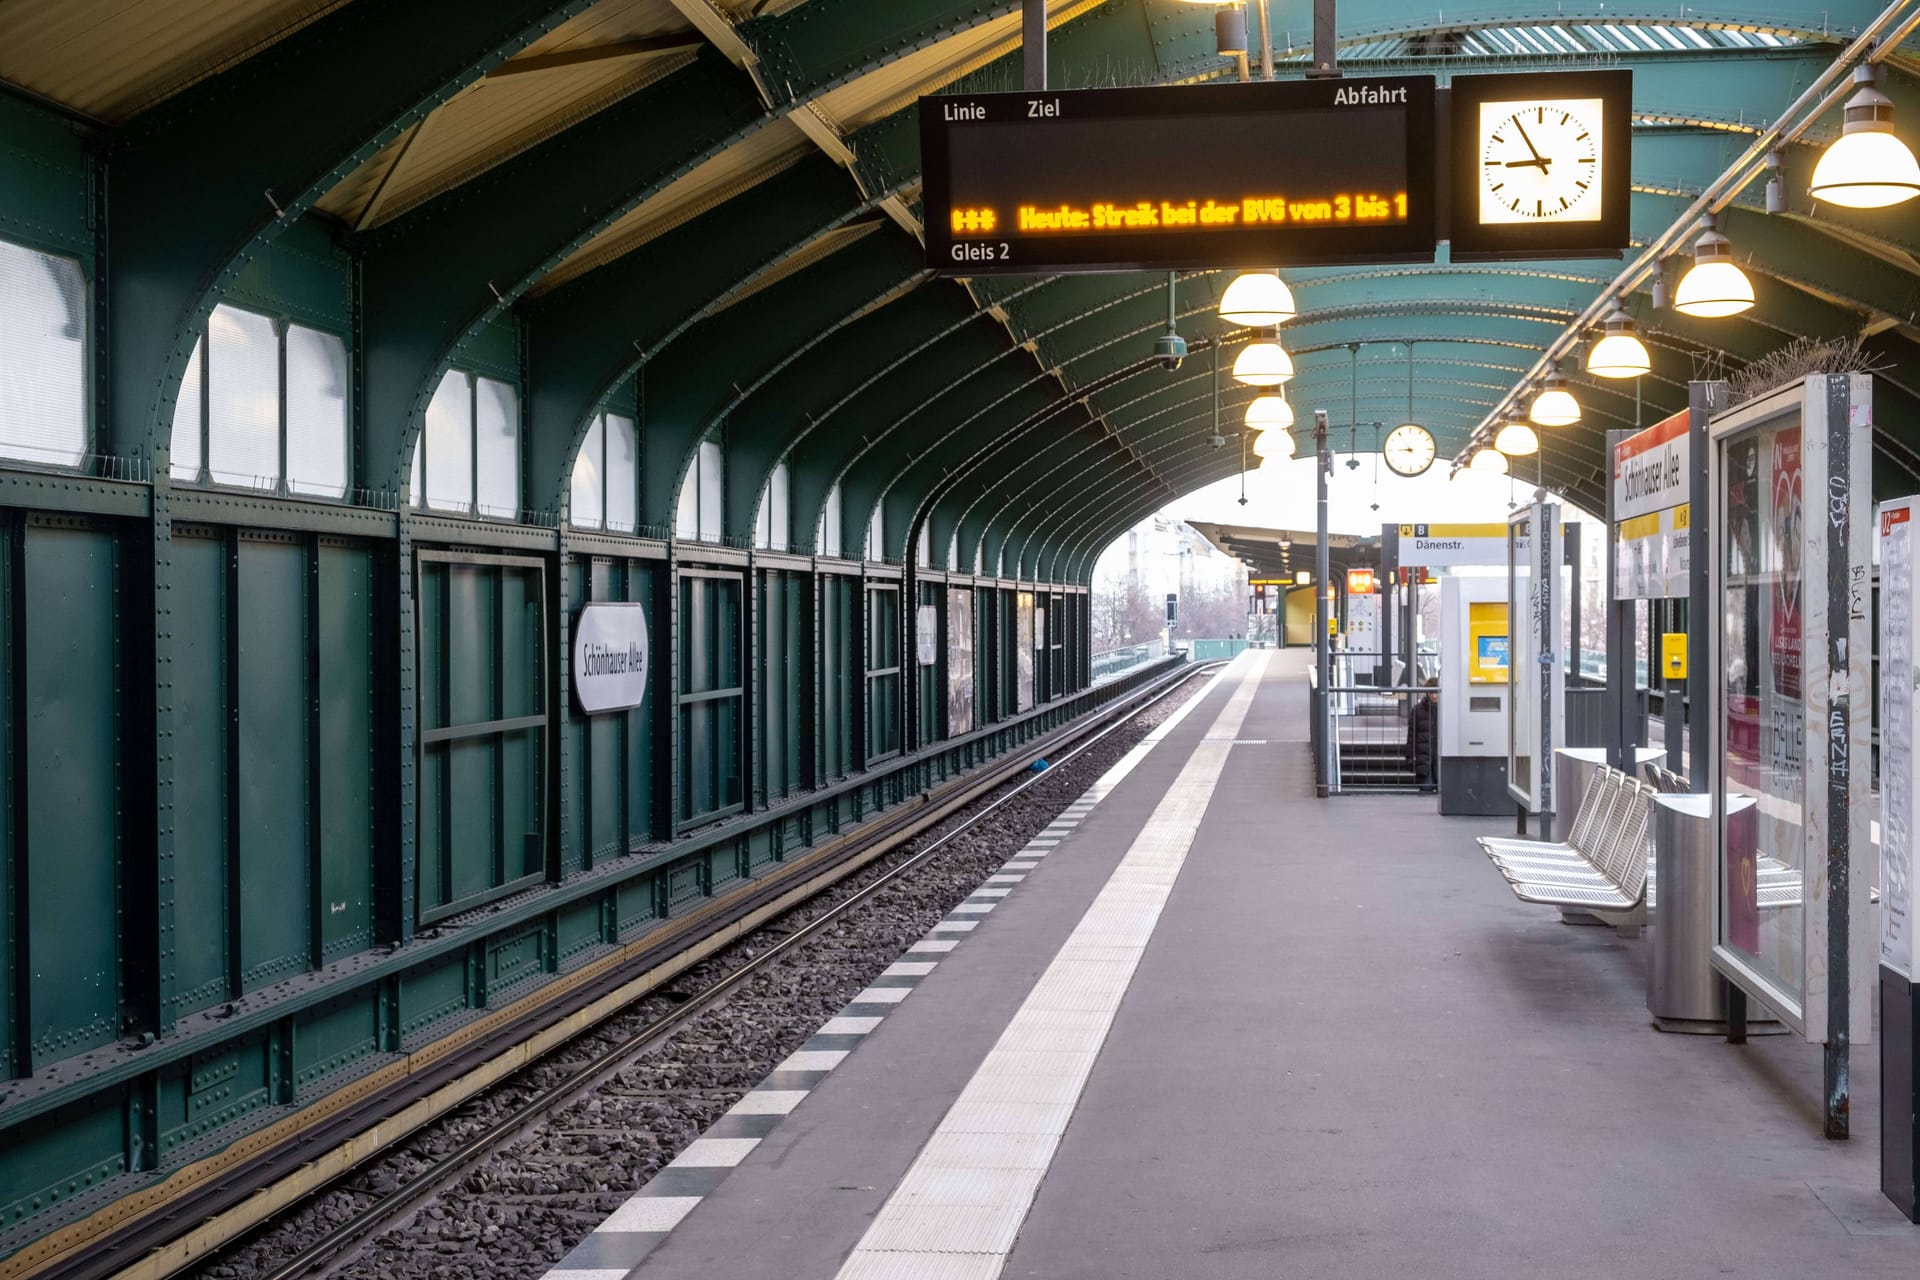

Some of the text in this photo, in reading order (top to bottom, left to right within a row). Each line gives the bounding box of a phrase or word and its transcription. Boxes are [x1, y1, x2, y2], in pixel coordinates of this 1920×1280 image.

[1334, 86, 1407, 105] Abfahrt
[944, 102, 986, 121] Linie
[1027, 98, 1060, 117] Ziel
[1093, 202, 1158, 226] Streik
[1162, 202, 1196, 225] bei
[1200, 200, 1239, 223] der
[1243, 198, 1285, 221] BVG
[1289, 202, 1331, 220] von
[1335, 196, 1350, 218] 3
[1356, 195, 1389, 218] bis
[951, 243, 1010, 261] Gleis 2
[1625, 444, 1679, 502] Schönhauser Allee
[1418, 525, 1425, 535] B
[1416, 540, 1465, 550] Dänenstr.
[583, 640, 643, 676] Schönhauser Allee
